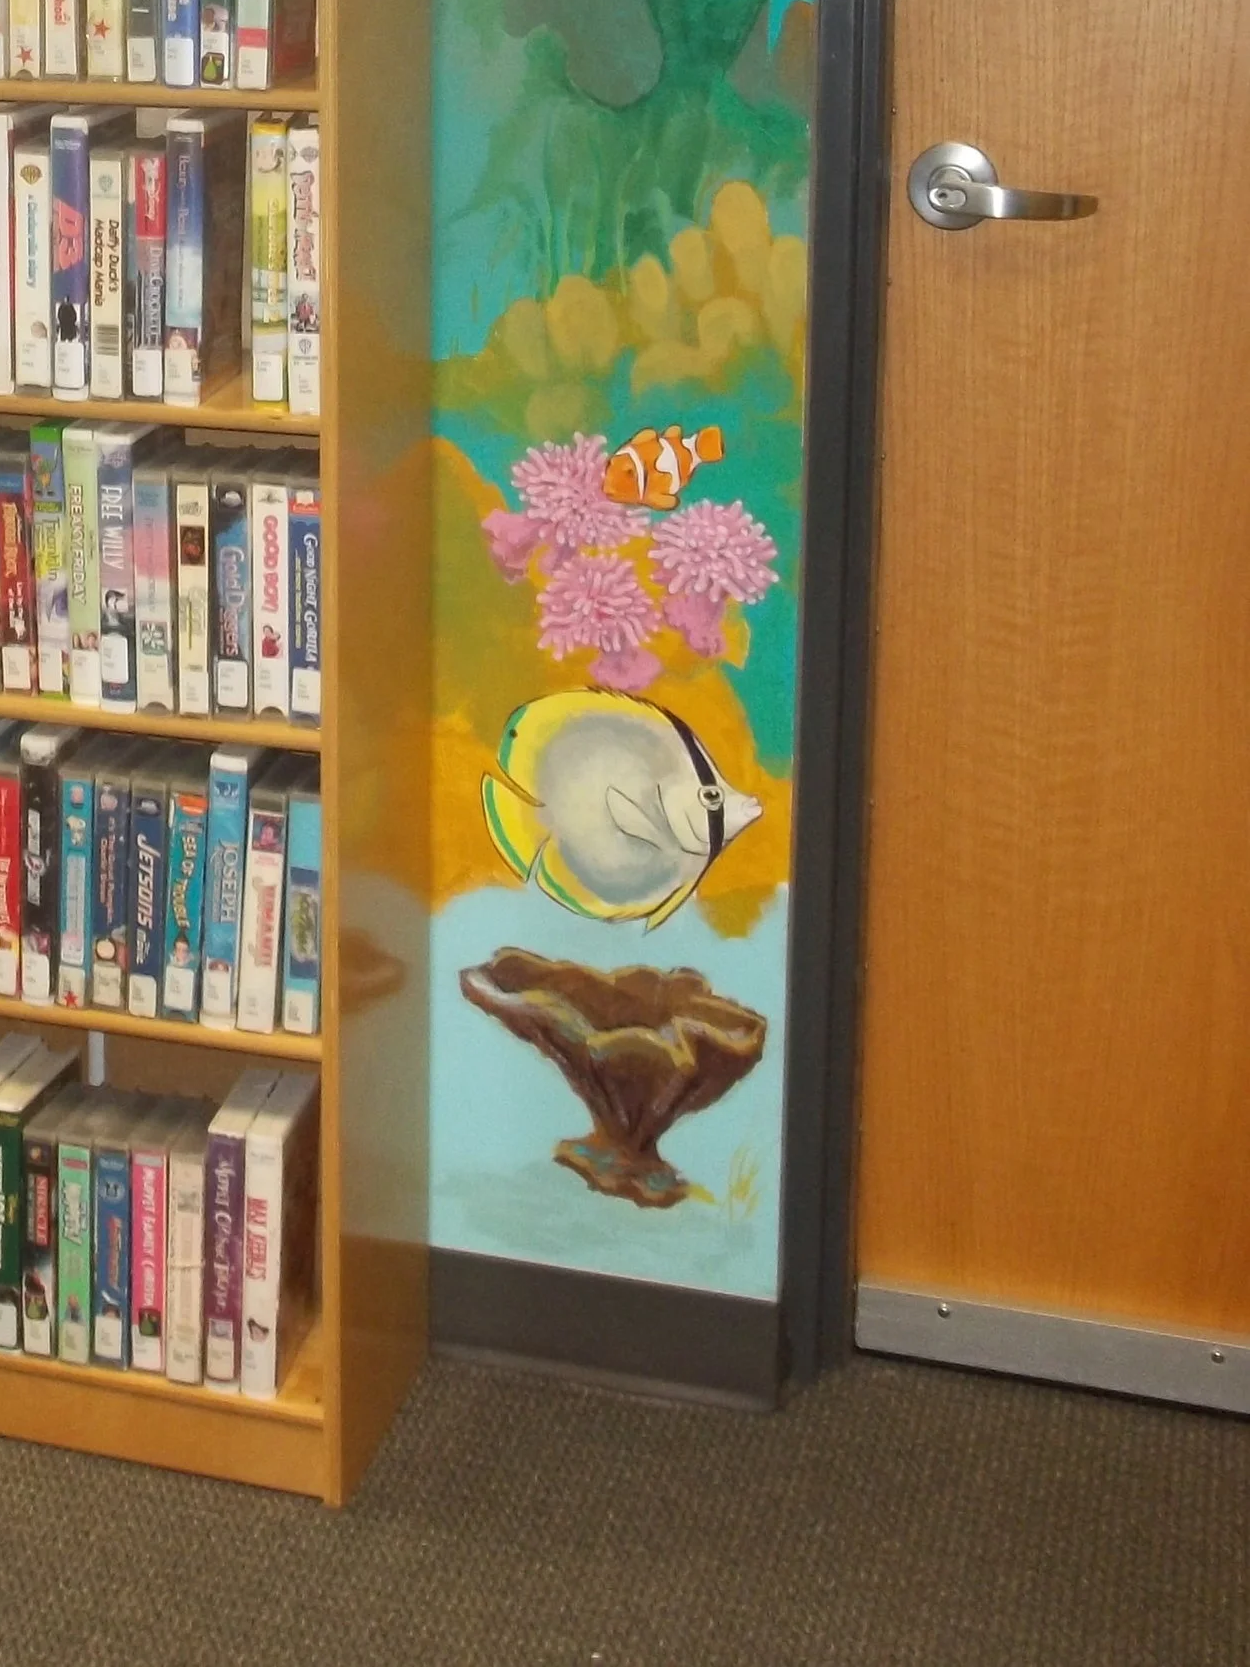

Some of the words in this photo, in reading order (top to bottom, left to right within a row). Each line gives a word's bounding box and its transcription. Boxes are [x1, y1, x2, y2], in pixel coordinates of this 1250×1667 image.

[92, 219, 104, 269] Madcap
[107, 219, 120, 253] Daffy
[26, 258, 38, 290] story
[94, 271, 104, 308] Mania
[108, 254, 119, 293] Duck's
[69, 484, 85, 545] FREAKY
[100, 484, 124, 521] FREE
[46, 517, 61, 582] Franklin
[101, 525, 125, 571] WILLY
[263, 515, 281, 571] GOOD
[70, 548, 86, 606] FRIDAY
[220, 545, 246, 592] Gold
[261, 572, 280, 614] BOY!
[222, 591, 245, 656] Diggers
[182, 836, 196, 856] SEA
[182, 860, 195, 875] OF
[136, 833, 162, 929] JETSONS
[174, 879, 190, 928] TROUBLE
[218, 840, 239, 924] JOSEPH
[136, 929, 148, 965] movie
[36, 1177, 48, 1245] MIRACLE
